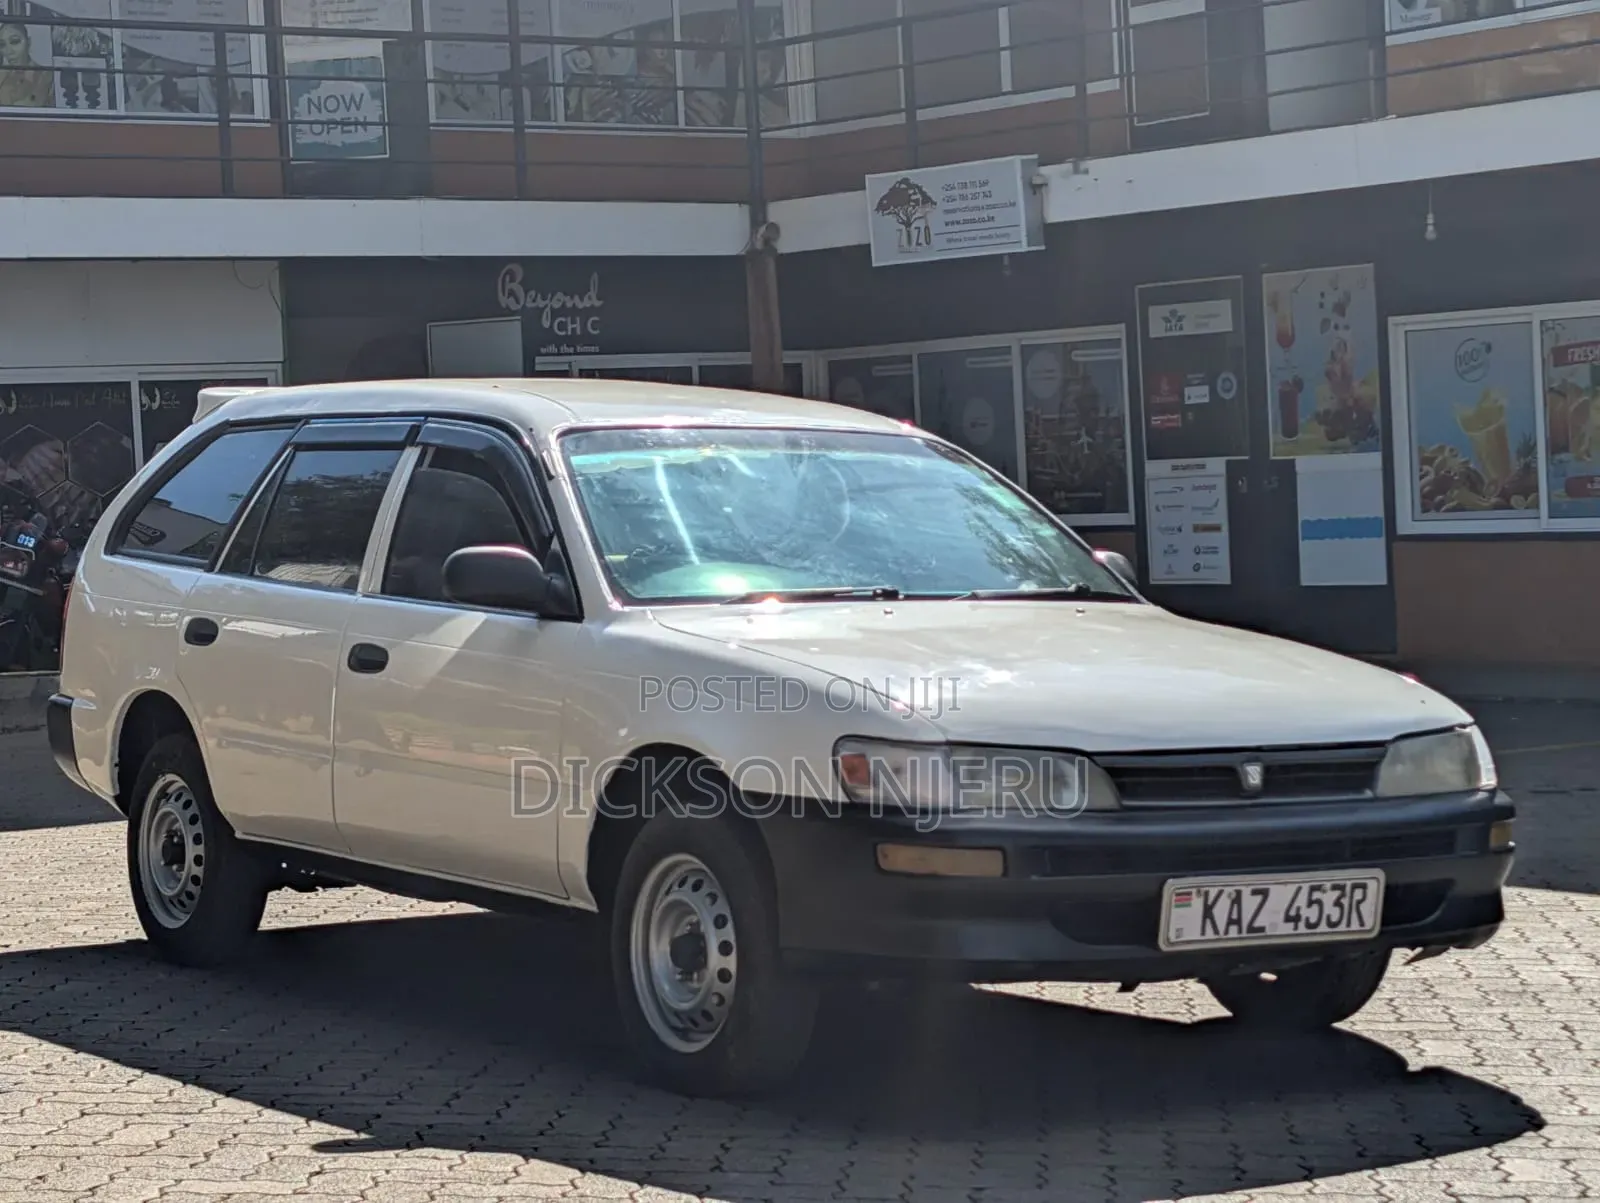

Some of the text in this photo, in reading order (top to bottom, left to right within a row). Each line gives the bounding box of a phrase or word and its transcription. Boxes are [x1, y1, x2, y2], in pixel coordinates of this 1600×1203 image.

[307, 93, 364, 115] NOW
[310, 116, 368, 136] OPEN
[498, 263, 604, 328] Beyond
[540, 344, 558, 354] with
[560, 343, 575, 354] the
[1200, 882, 1368, 936] KAZ 453R
